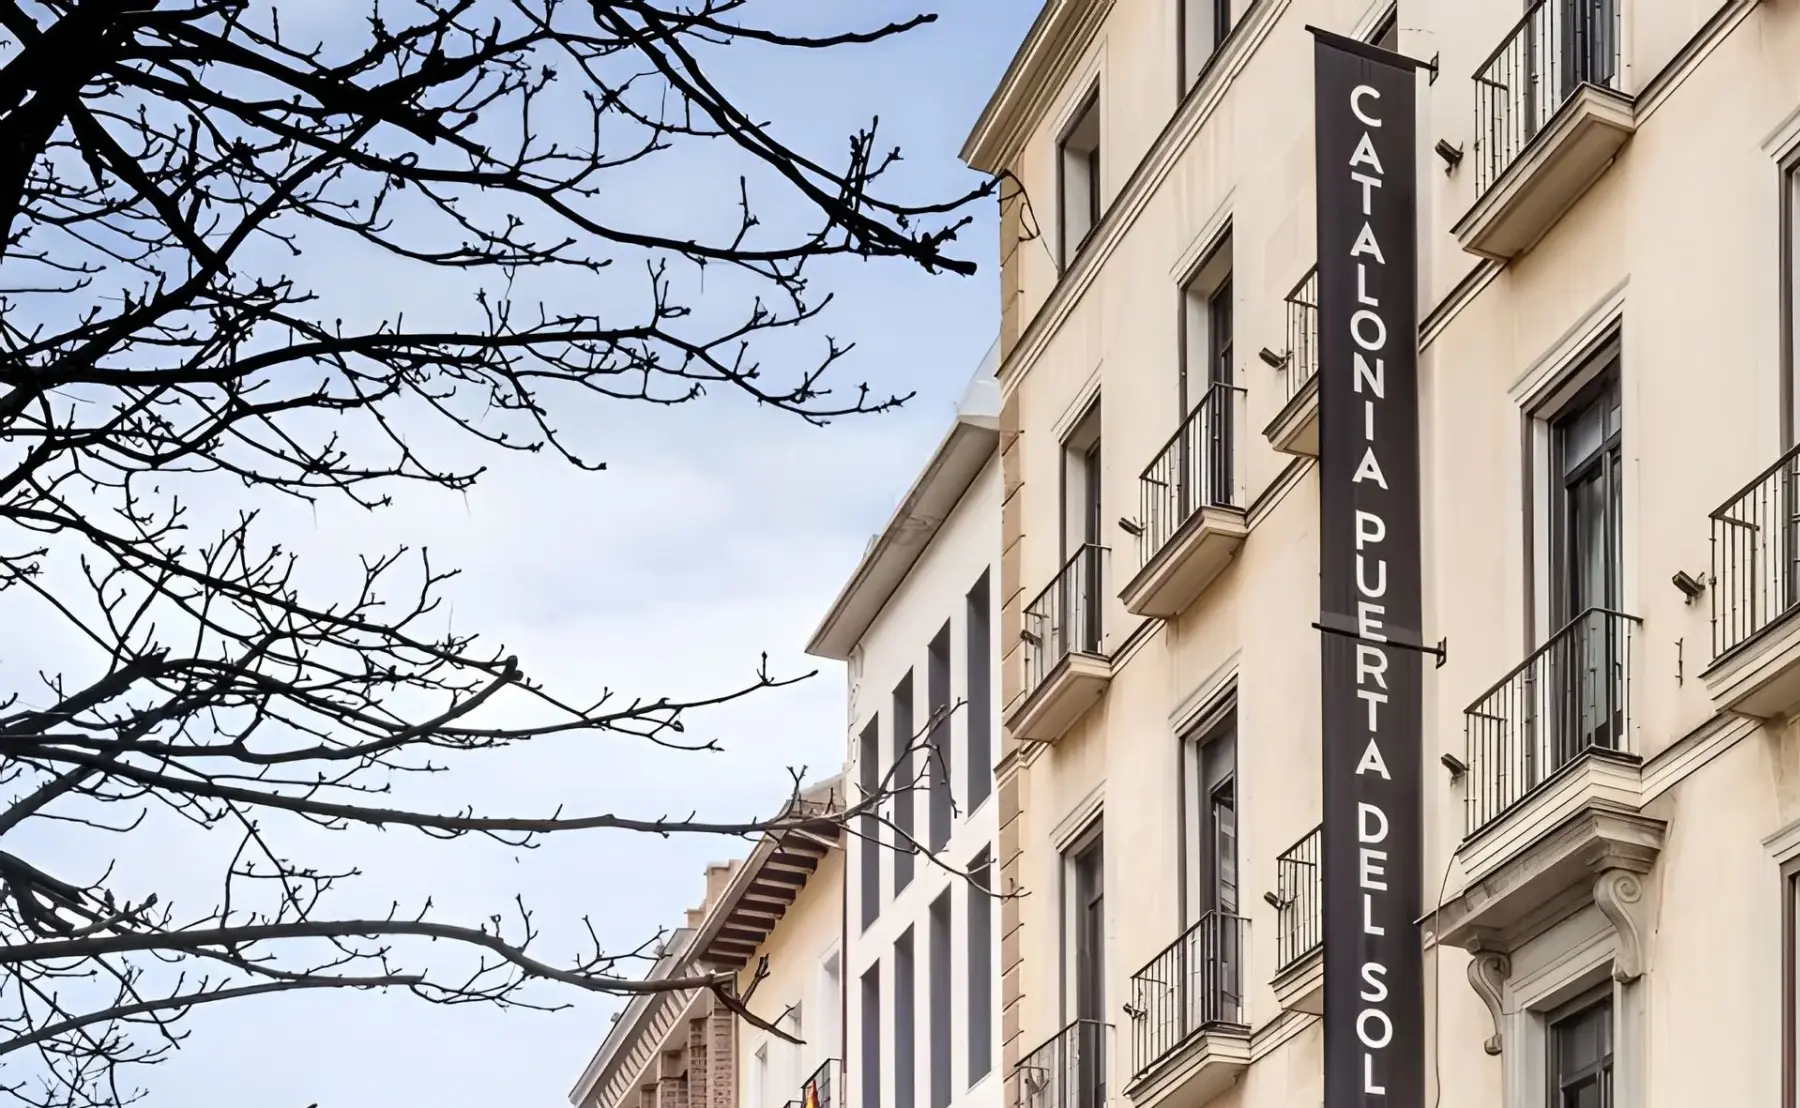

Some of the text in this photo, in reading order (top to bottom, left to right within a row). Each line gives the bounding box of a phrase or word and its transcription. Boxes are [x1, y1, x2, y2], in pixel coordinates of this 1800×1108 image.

[1350, 84, 1393, 1096] CATALONIA PUERTA DEL SOL
